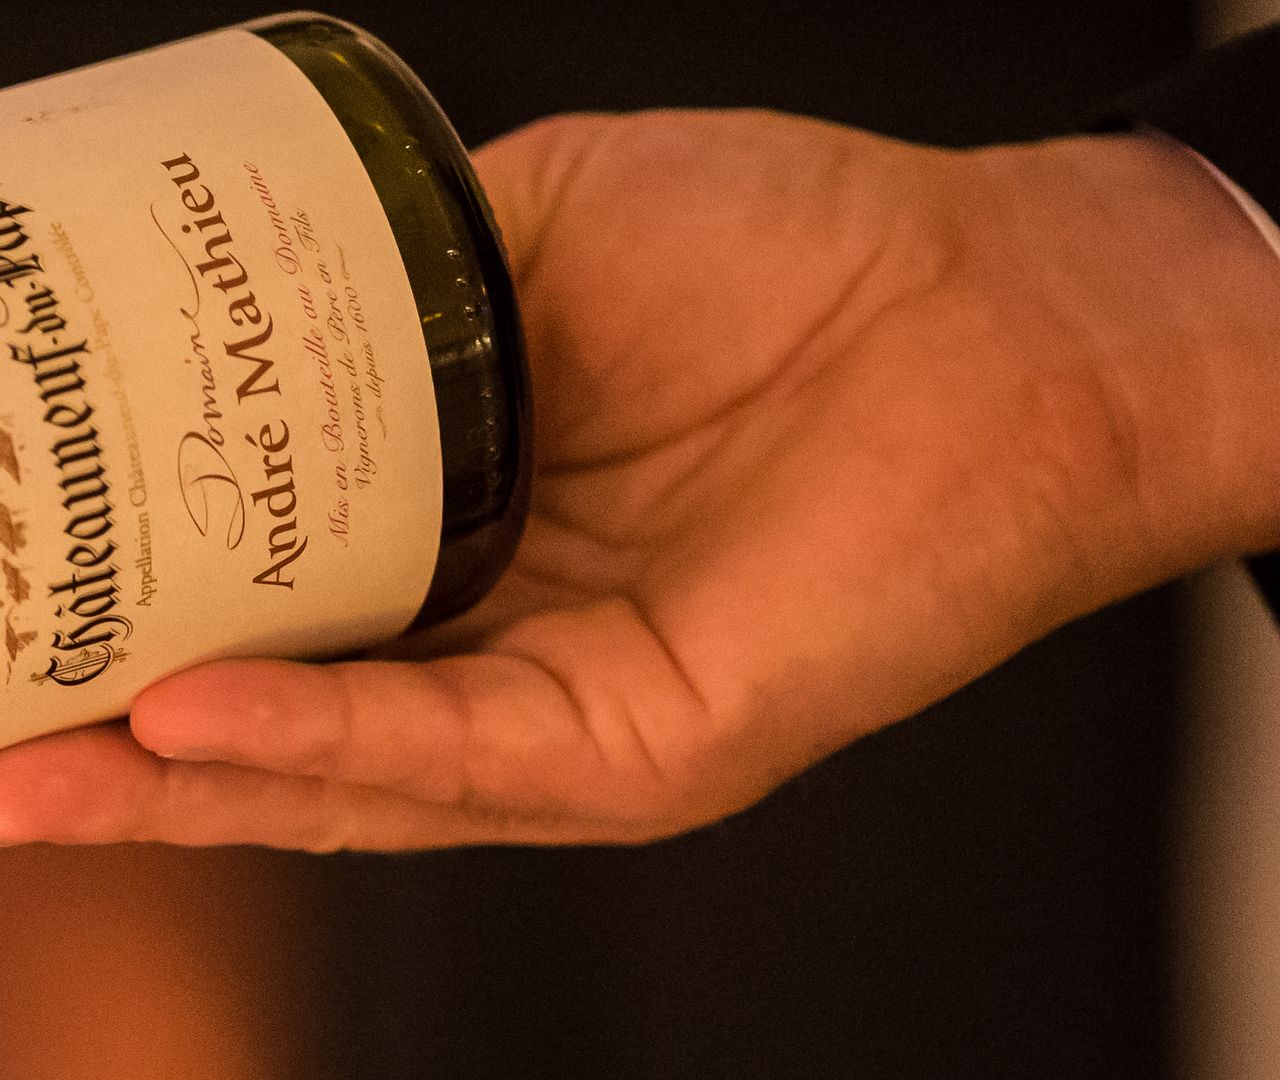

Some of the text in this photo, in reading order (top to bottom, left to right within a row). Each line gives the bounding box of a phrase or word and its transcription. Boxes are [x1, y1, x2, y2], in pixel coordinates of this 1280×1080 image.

[290, 207, 321, 253] Fils
[316, 259, 333, 284] en
[160, 151, 309, 591] André Mathieu
[243, 160, 351, 549] Mis en Bouteille au Domaine
[337, 351, 357, 378] de
[344, 285, 385, 399] depuis 1600
[350, 381, 378, 490] Vignerons
[134, 511, 158, 608] Appellation
